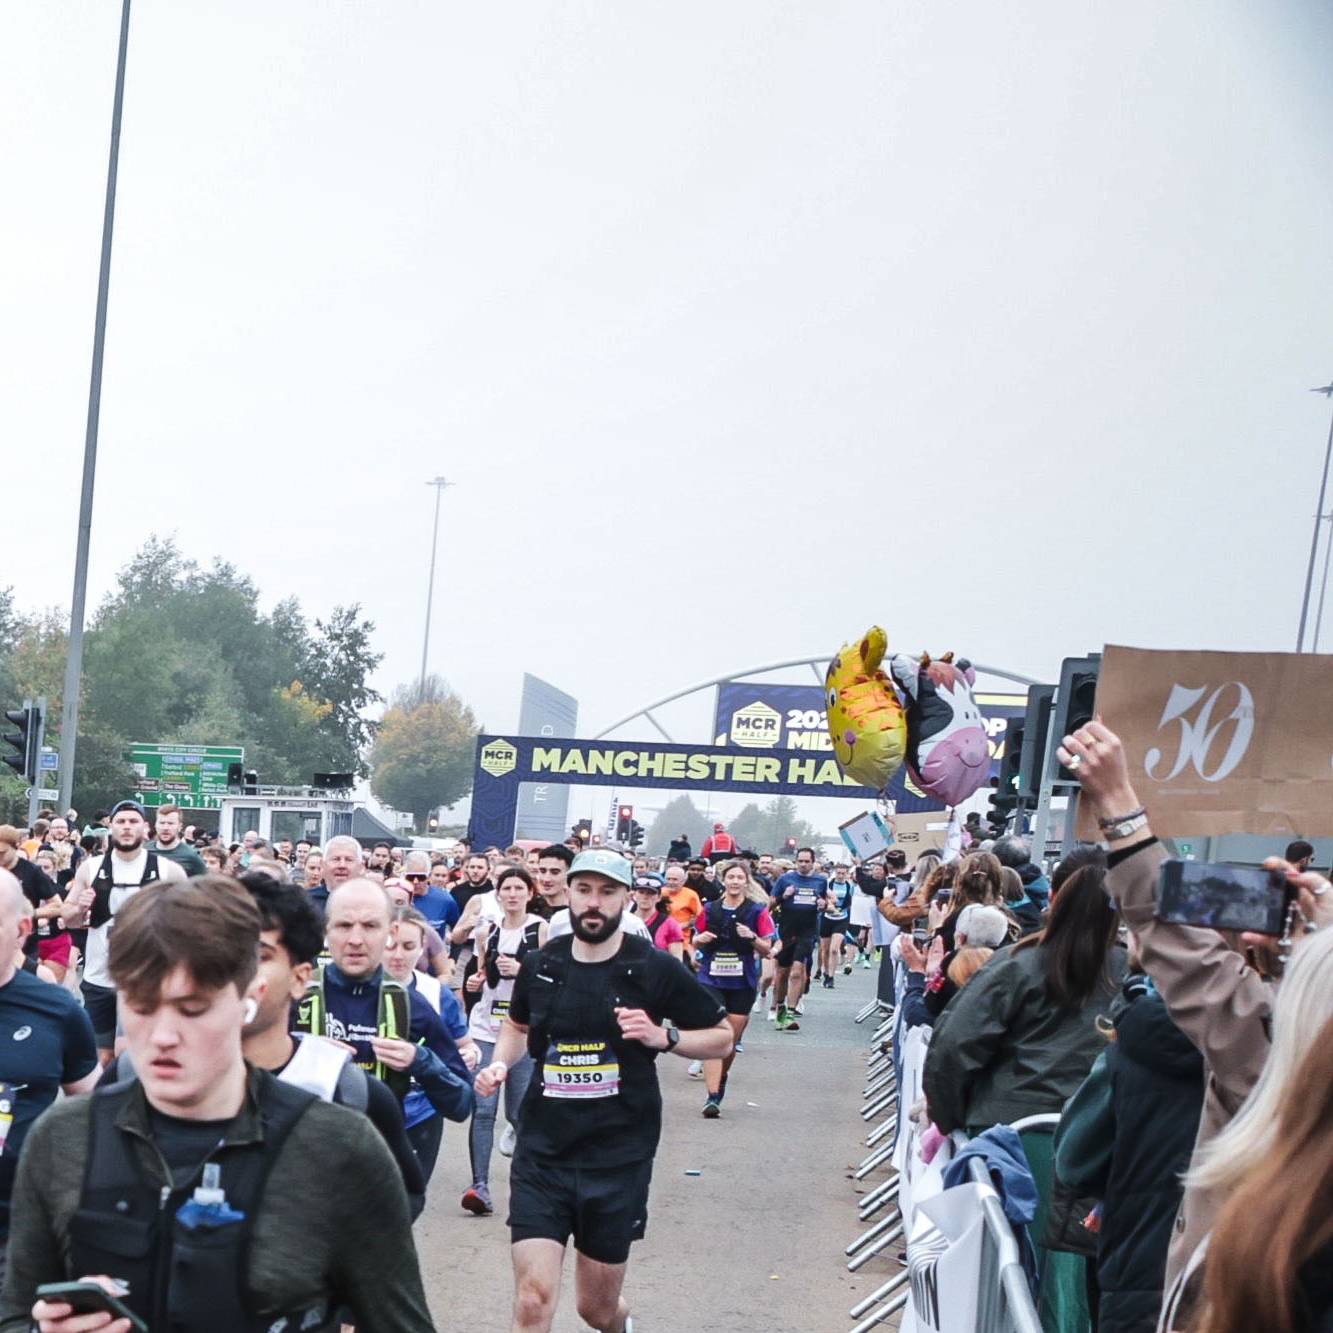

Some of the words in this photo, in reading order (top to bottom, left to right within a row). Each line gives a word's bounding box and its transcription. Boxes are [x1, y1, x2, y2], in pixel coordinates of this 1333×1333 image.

[736, 717, 776, 730] MCR
[484, 750, 513, 760] MCR
[531, 747, 781, 783] MANCHESTER
[787, 758, 864, 786] HA
[559, 1054, 599, 1066] CHRIS
[557, 1072, 603, 1083] 19350
